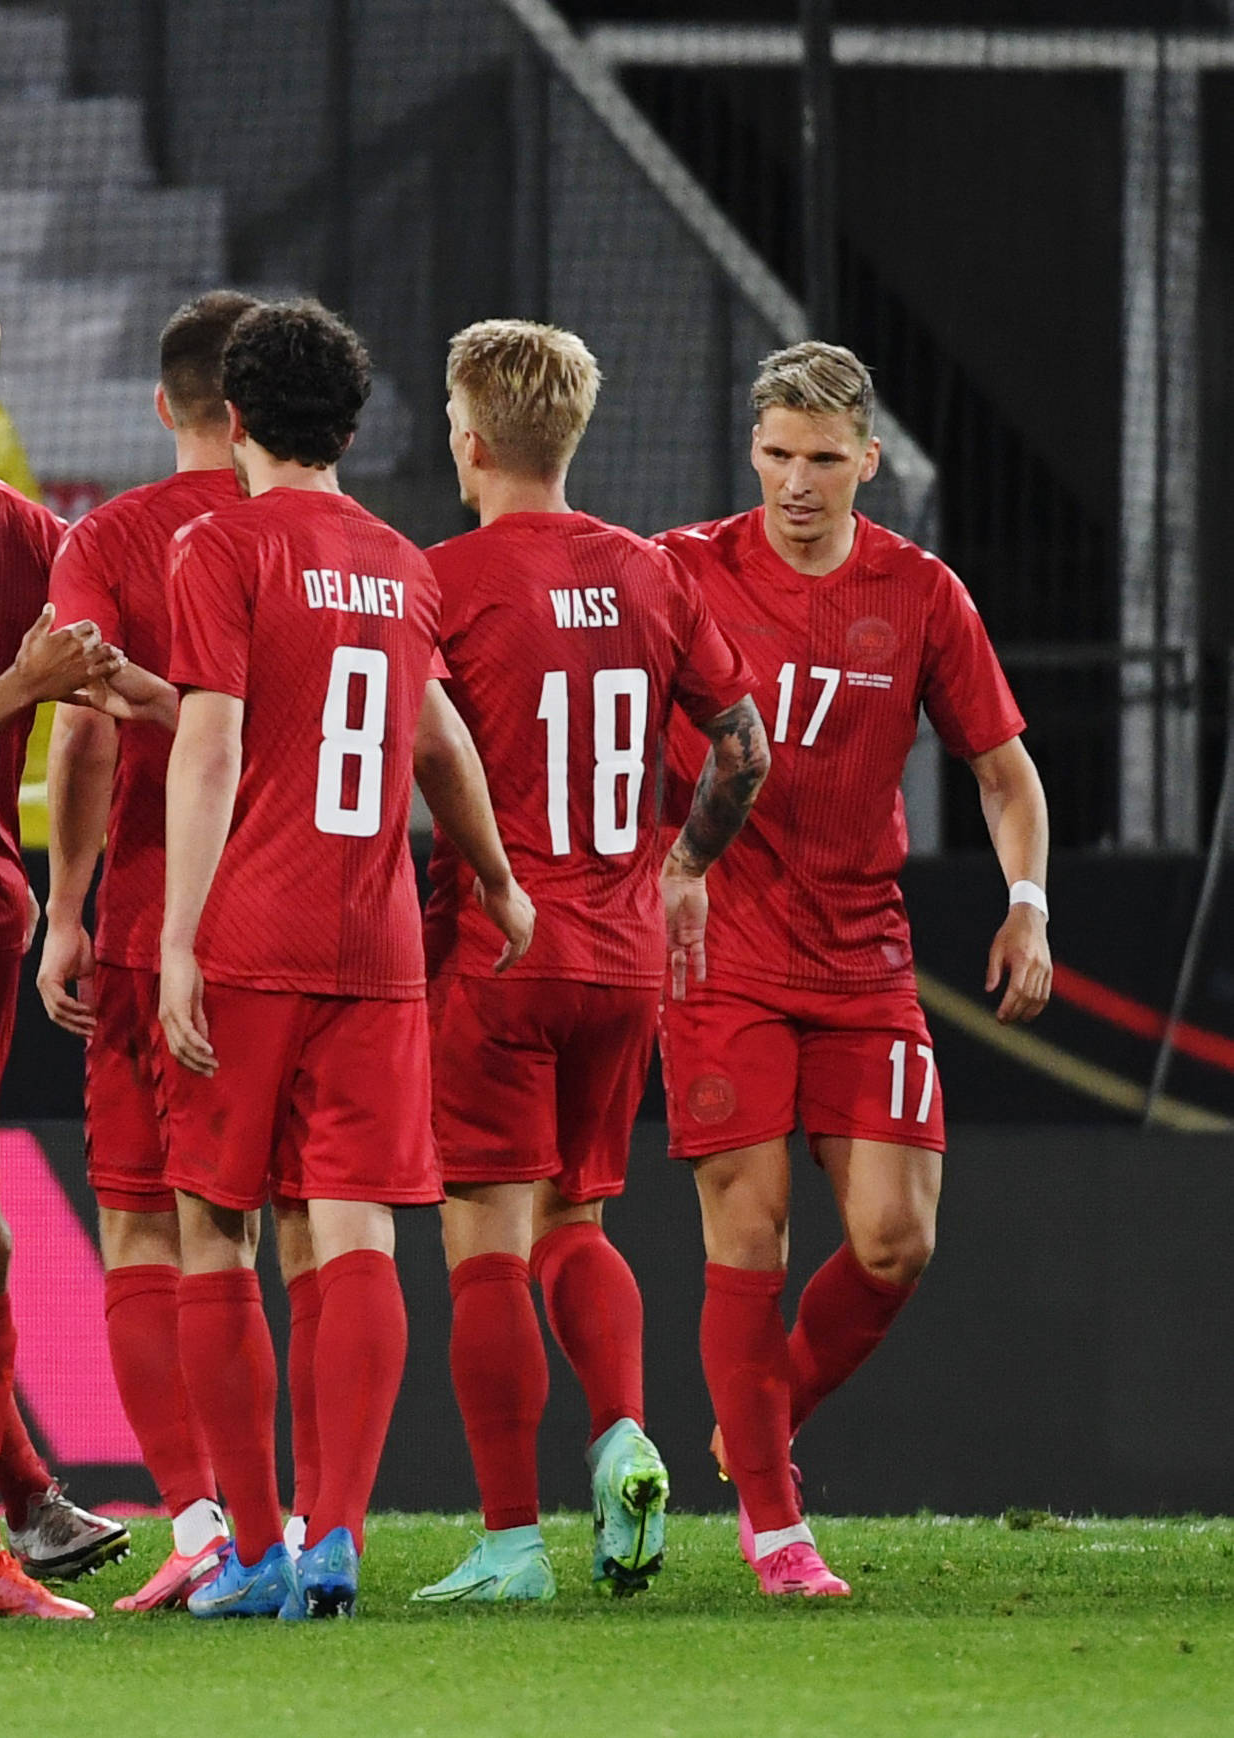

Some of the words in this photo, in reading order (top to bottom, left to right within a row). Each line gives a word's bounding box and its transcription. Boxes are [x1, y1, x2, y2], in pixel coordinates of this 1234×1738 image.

[302, 568, 406, 620] DELANEY
[548, 586, 619, 629] WASS
[314, 645, 389, 838] 8
[773, 662, 841, 747] 17
[536, 668, 649, 856] 18
[888, 1040, 934, 1124] 17
